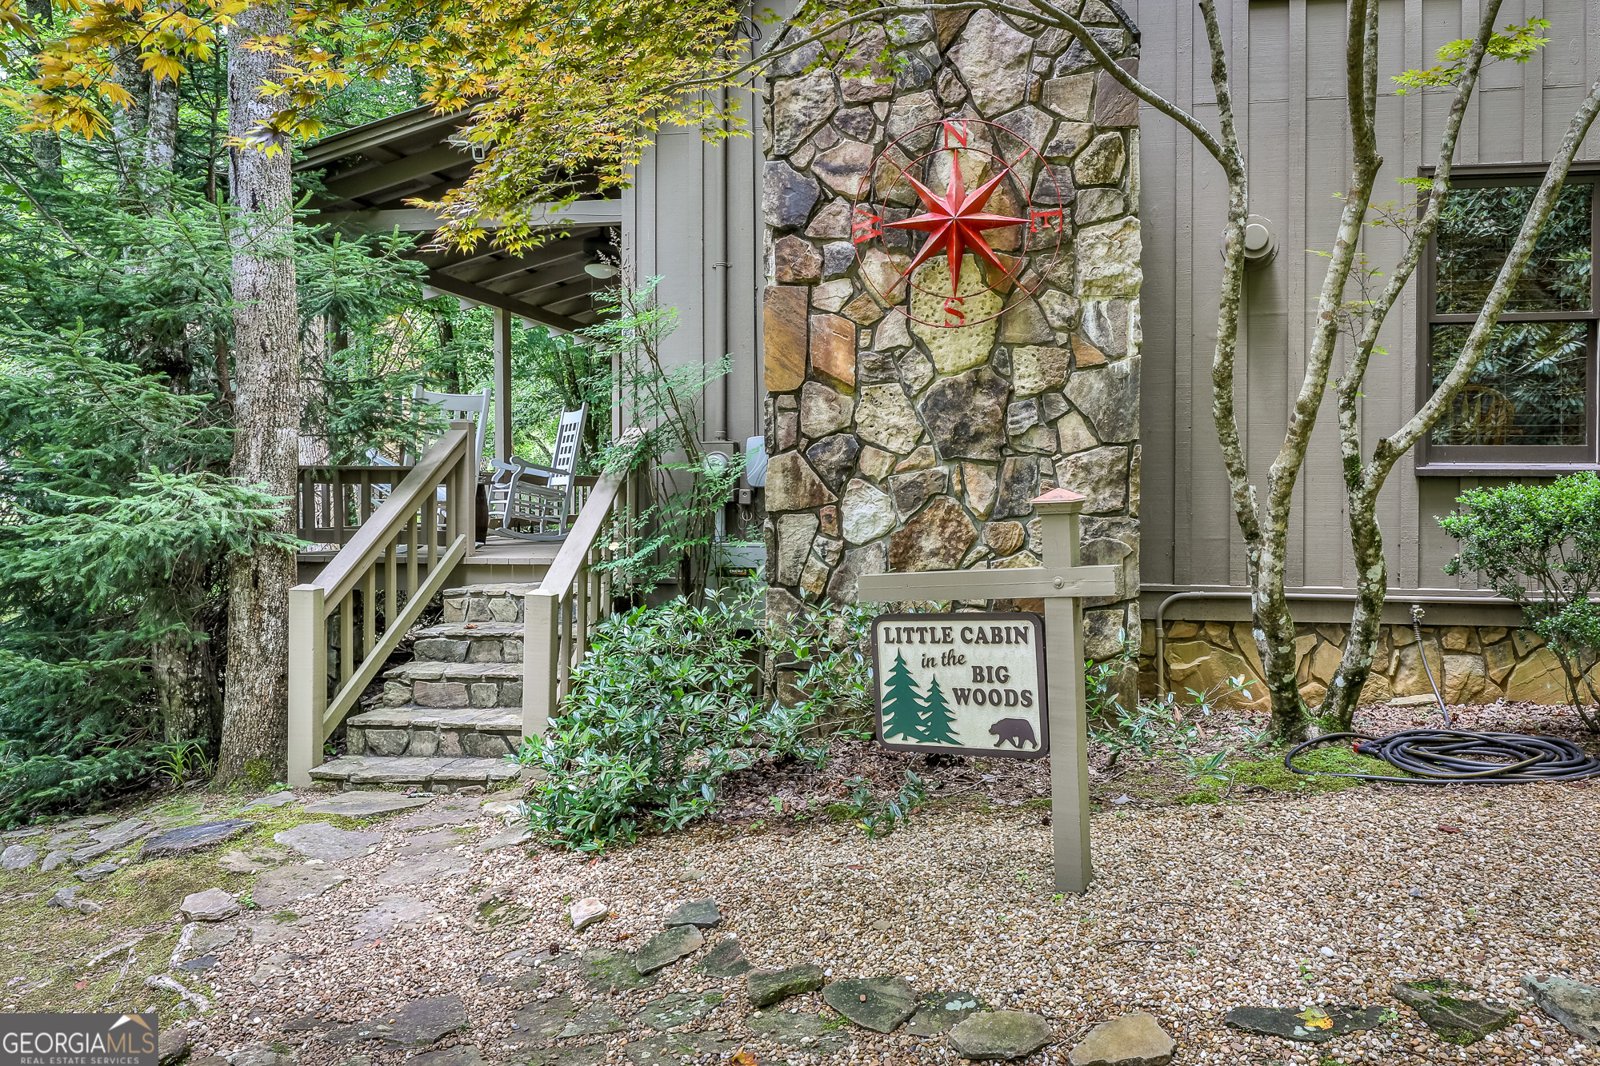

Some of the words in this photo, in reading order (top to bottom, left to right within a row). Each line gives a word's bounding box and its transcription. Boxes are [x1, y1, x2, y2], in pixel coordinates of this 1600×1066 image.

[943, 120, 967, 149] N
[1030, 209, 1063, 233] E
[943, 297, 965, 327] S
[883, 626, 954, 645] LITTLE
[960, 626, 1029, 645] CABIN
[921, 653, 937, 669] in
[941, 649, 967, 666] the
[971, 665, 1010, 684] BIG
[952, 687, 1033, 708] WOODS
